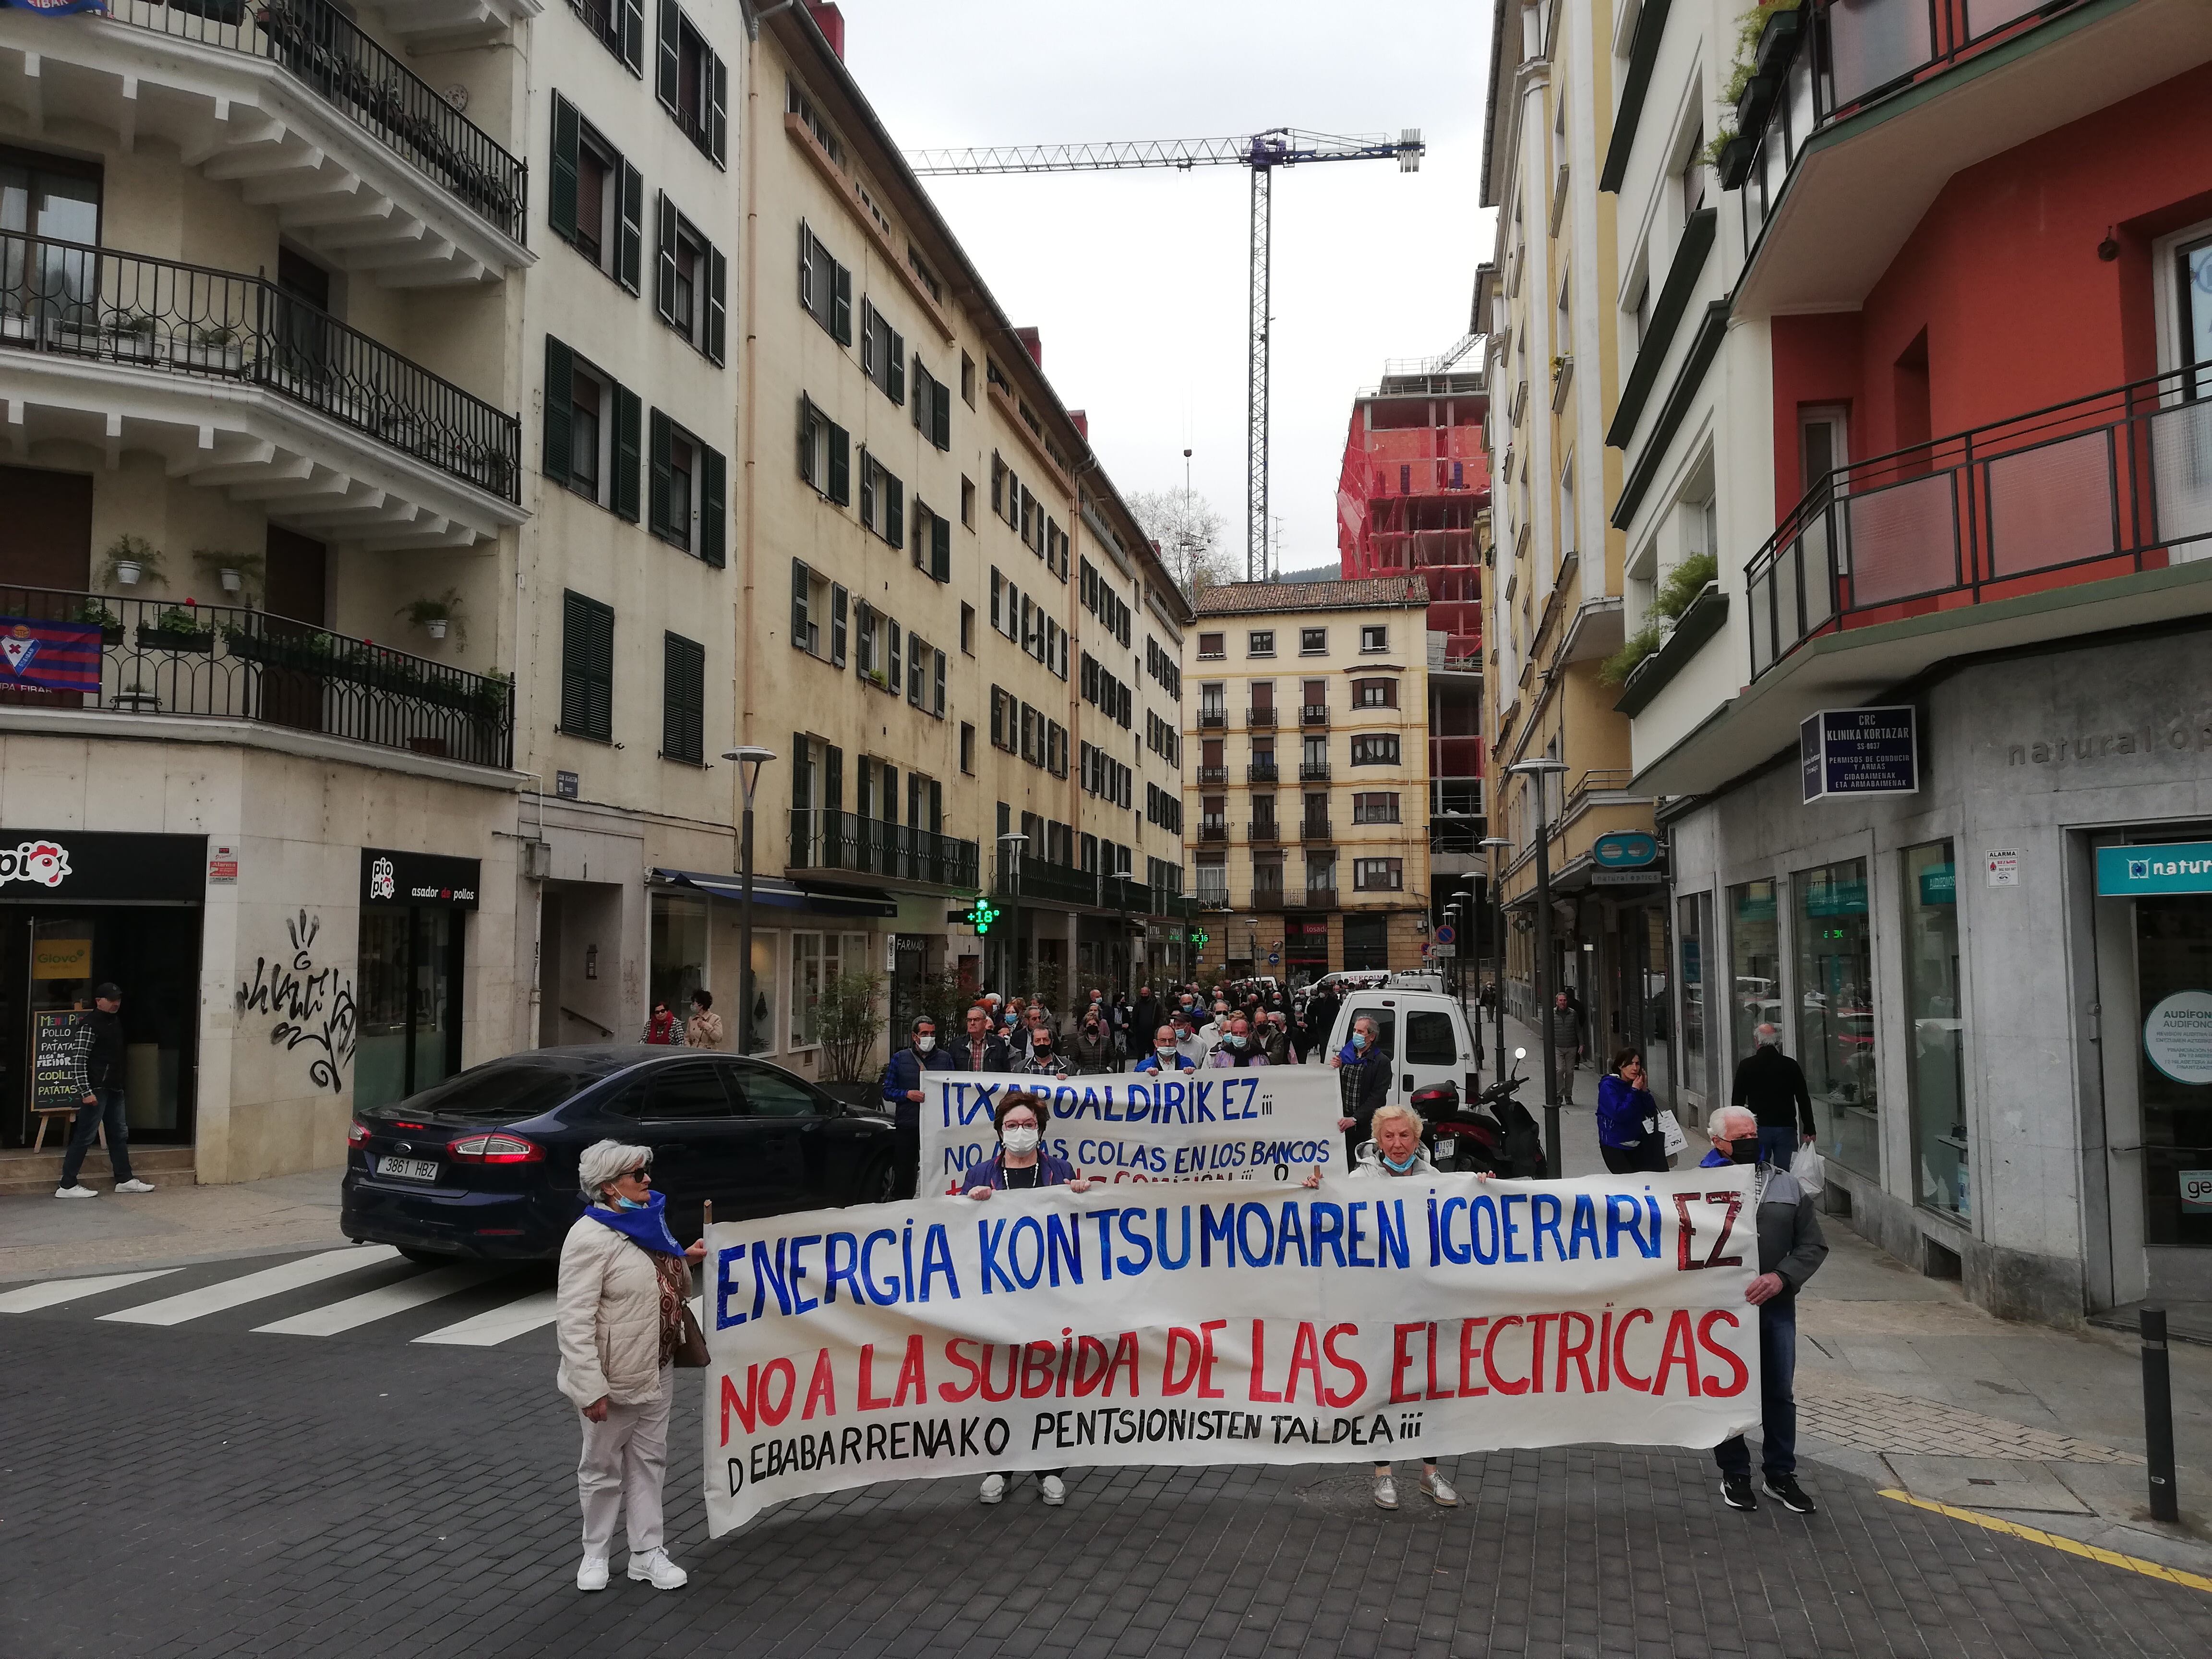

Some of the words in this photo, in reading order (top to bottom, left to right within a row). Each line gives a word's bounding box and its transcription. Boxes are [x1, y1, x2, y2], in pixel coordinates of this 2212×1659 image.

[1859, 714, 1876, 726] CRC
[1827, 729, 1862, 741] KLINIKA
[1864, 727, 1909, 740] KORTAZAR
[2008, 725, 2151, 766] natural
[1829, 756, 1863, 764] PERMISOS
[1844, 772, 1896, 781] GIDABAIMENAK
[1851, 780, 1907, 788] ARMABAIMENAK
[373, 859, 392, 878] pio
[411, 886, 439, 898] asador
[441, 888, 451, 899] de
[453, 888, 474, 901] pollos
[37, 953, 77, 963] Glovo
[42, 1028, 71, 1037] POLLO
[41, 1042, 75, 1051] PATATA
[38, 1084, 78, 1095] PATATAS
[942, 1077, 1217, 1128] ITXOALDIRIK
[1222, 1077, 1260, 1121] EZ
[1440, 1140, 1453, 1149] 1108
[944, 1143, 982, 1175] NO
[1039, 1138, 1070, 1161] AS
[1078, 1139, 1167, 1173] COLAS
[1174, 1144, 1207, 1174] EN
[1210, 1142, 1246, 1169] LOS
[1250, 1139, 1330, 1166] BANCOS
[385, 1158, 410, 1175] 3861
[415, 1163, 437, 1178] HBZ
[977, 1199, 1411, 1295] KONTSUMOAREN
[1672, 1190, 1745, 1272] EZ
[720, 1357, 797, 1448] NO
[801, 1347, 837, 1420] A
[857, 1334, 927, 1412] LA
[938, 1326, 1140, 1403] SUBIDA
[1161, 1319, 1227, 1399] DE
[1249, 1318, 1368, 1408] LAS
[727, 1416, 1010, 1498] DEBABARRENAKO
[1031, 1407, 1262, 1451] PENTSIONISTEN
